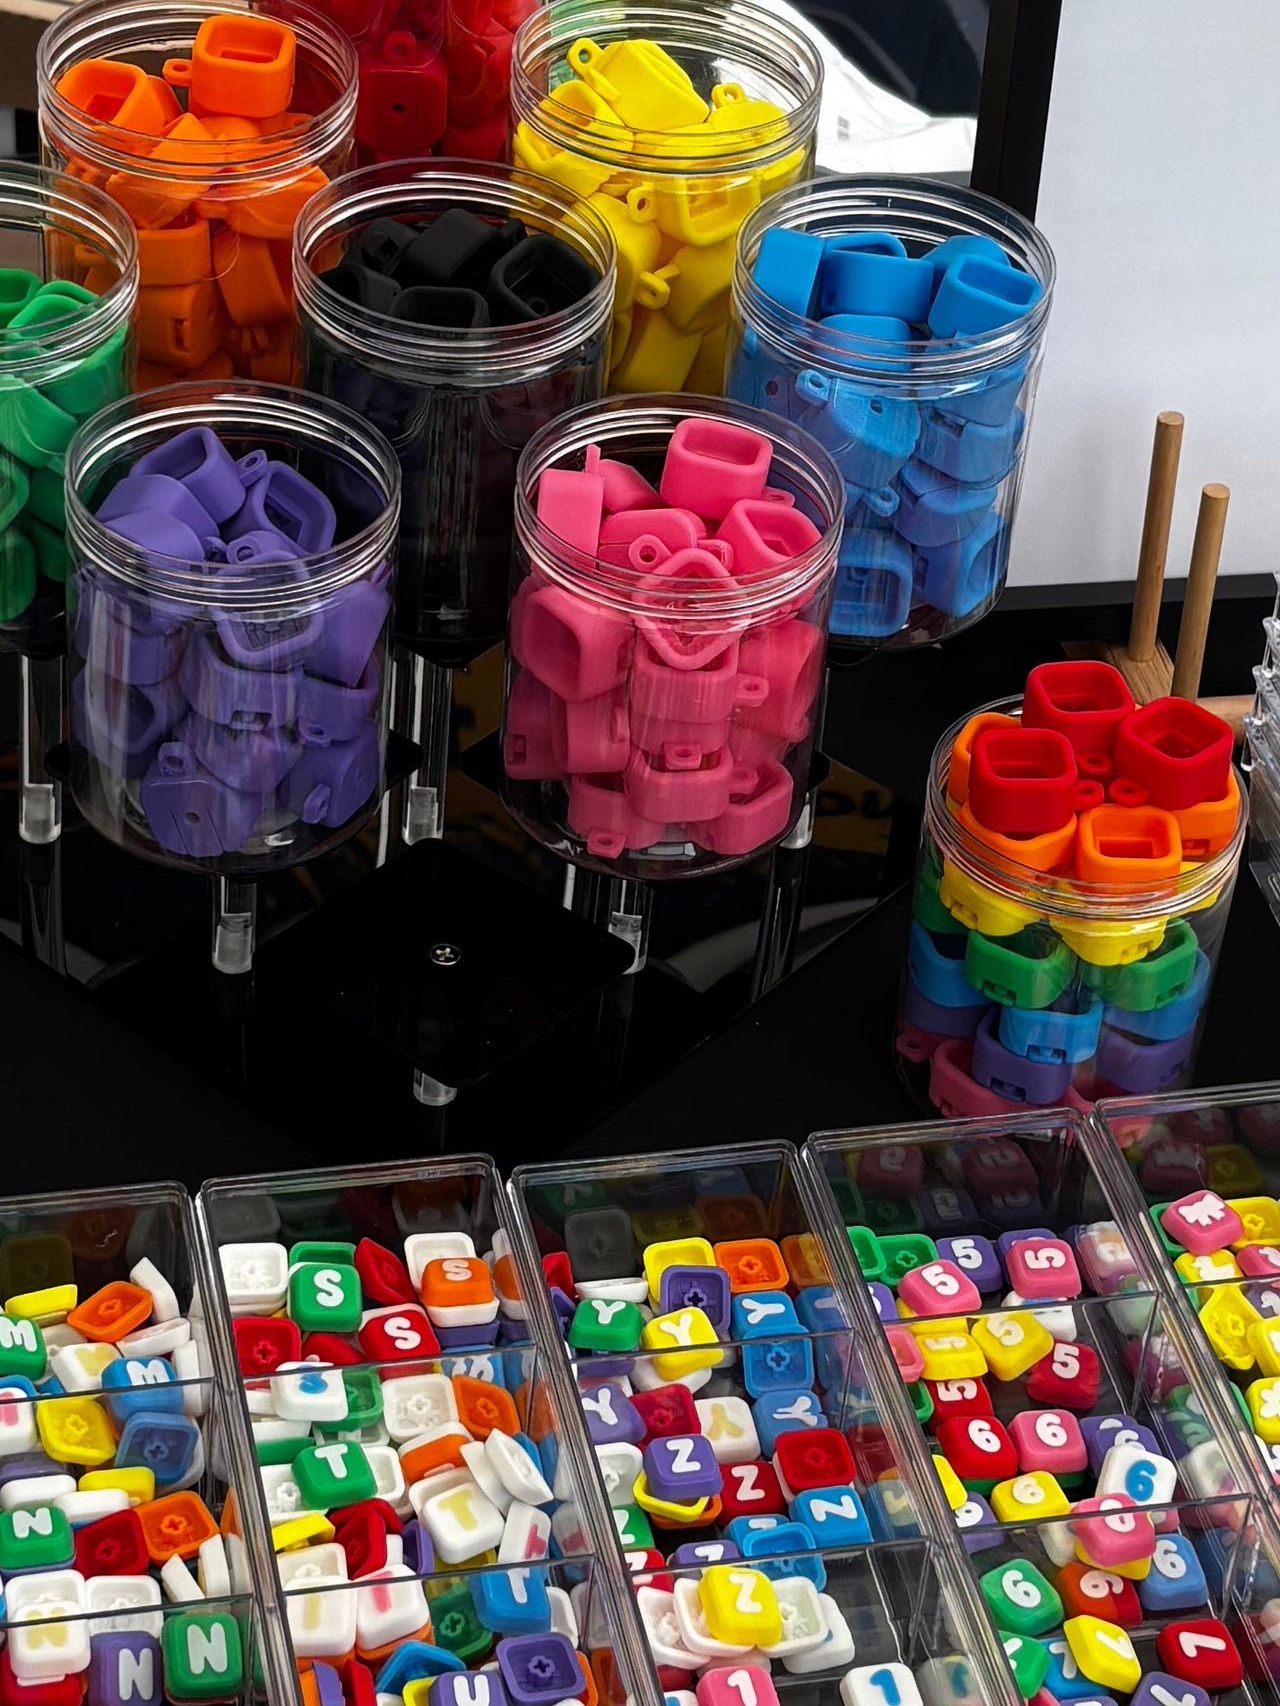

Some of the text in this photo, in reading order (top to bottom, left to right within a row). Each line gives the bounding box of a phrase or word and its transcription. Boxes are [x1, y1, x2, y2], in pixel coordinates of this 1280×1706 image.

[443, 1260, 472, 1281] S
[952, 1239, 982, 1268] 5
[314, 1270, 343, 1306] S
[929, 1266, 958, 1294] 5
[591, 1299, 625, 1324] Y
[742, 1299, 785, 1324] Y
[384, 1317, 420, 1349] S
[660, 1313, 692, 1346] Y
[989, 1320, 1025, 1346] 5
[127, 1360, 169, 1385] M
[1053, 1343, 1079, 1378] 5
[582, 1388, 618, 1425] Y
[977, 1421, 1000, 1452] 6
[1036, 1414, 1067, 1446] 6
[315, 1443, 348, 1478] T
[667, 1439, 700, 1472] Z
[732, 1465, 764, 1500] Z
[1124, 1461, 1156, 1493] 6
[13, 1508, 52, 1537] N
[441, 1492, 479, 1529] T
[1153, 1540, 1186, 1578] 6
[729, 1573, 761, 1613] Z
[1002, 1570, 1041, 1607] 6
[27, 1608, 66, 1649] N
[187, 1623, 227, 1674] N
[119, 1648, 151, 1700] N
[728, 1670, 757, 1706] 1
[870, 1670, 900, 1706] 1
